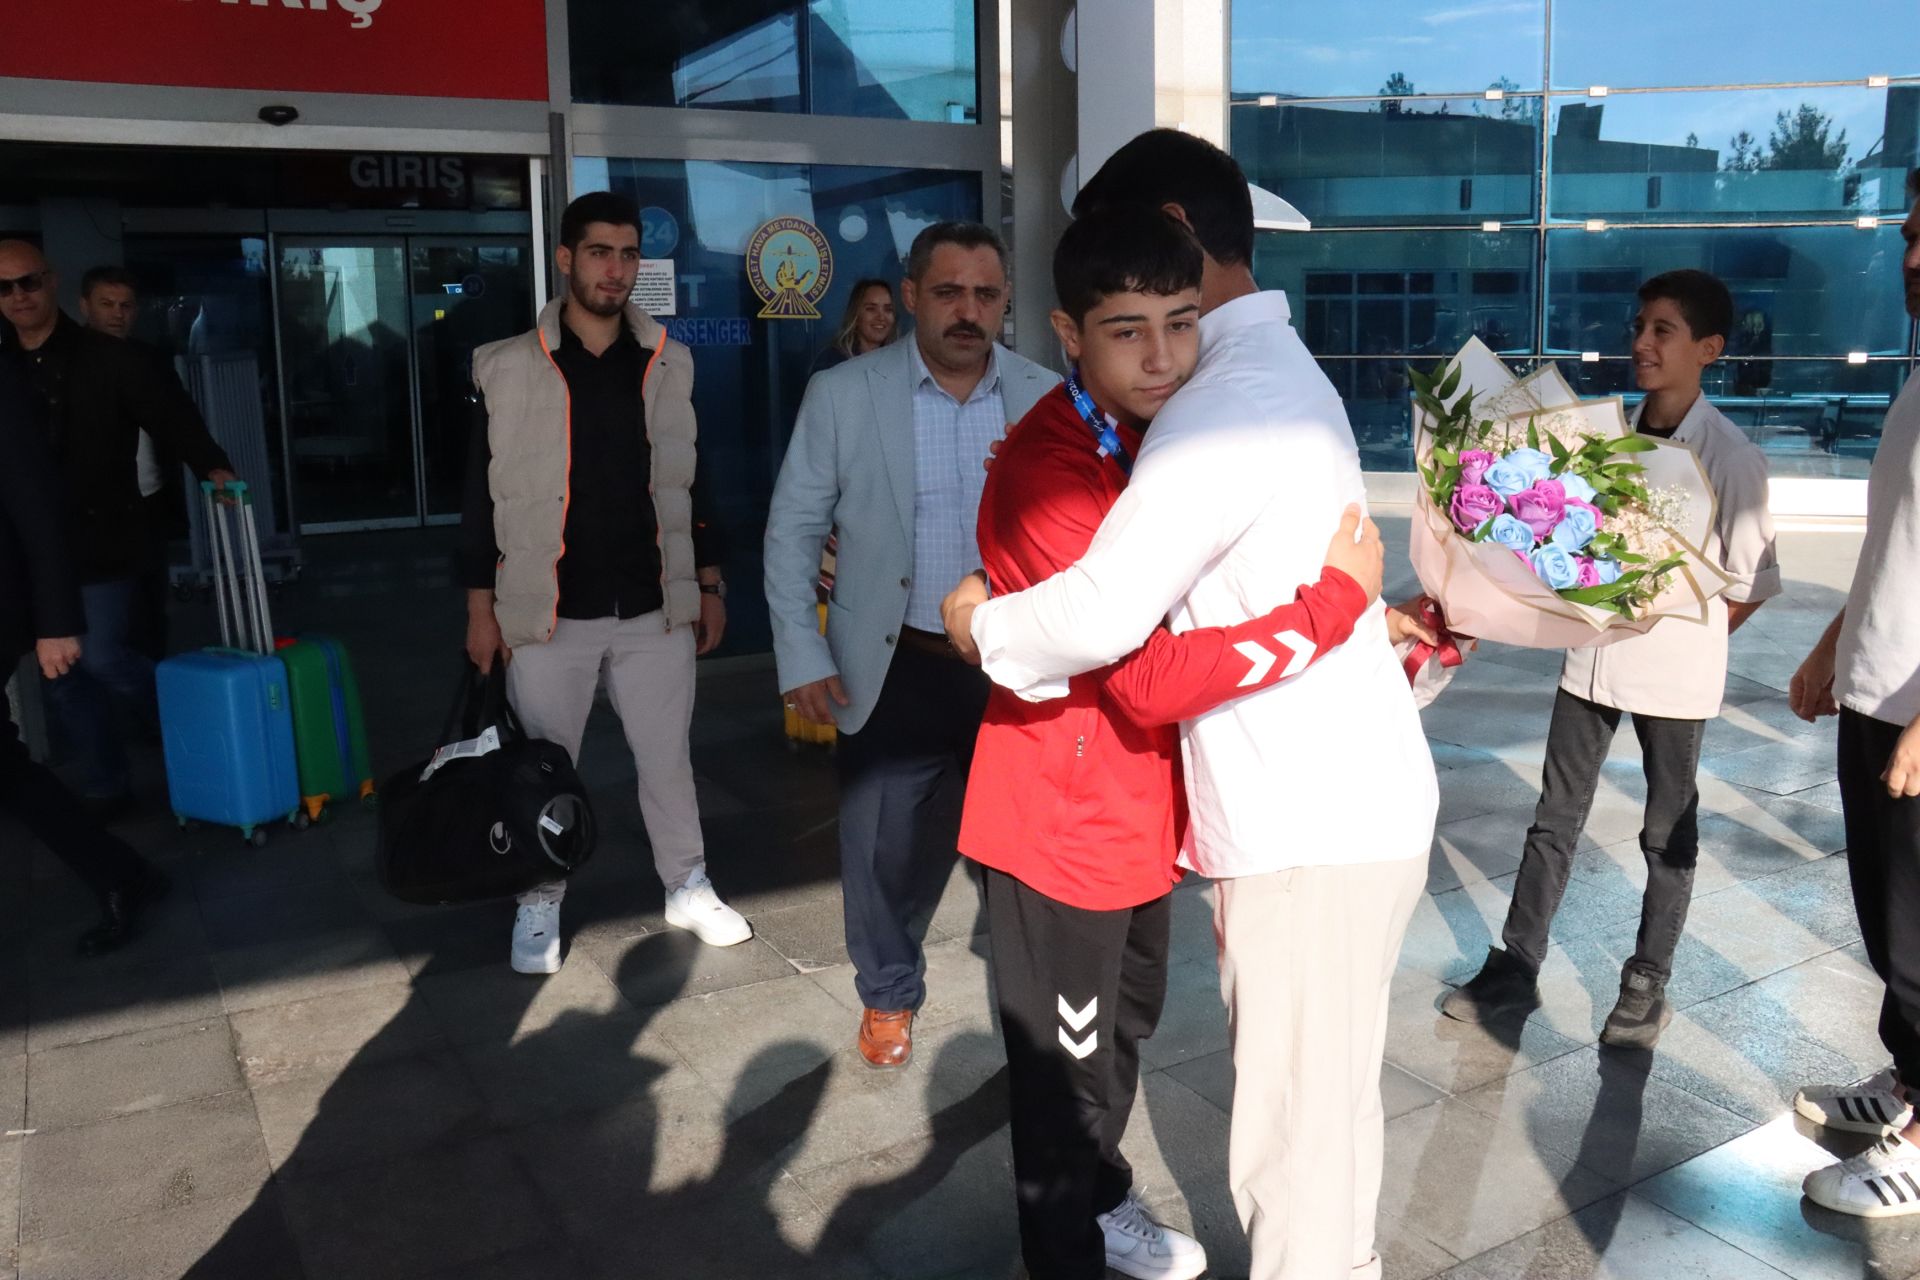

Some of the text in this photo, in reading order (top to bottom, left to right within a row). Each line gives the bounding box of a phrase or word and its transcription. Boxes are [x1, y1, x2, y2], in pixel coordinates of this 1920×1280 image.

[641, 221, 674, 244] 24
[751, 232, 769, 258] HAVA
[767, 219, 824, 248] MEYDANLARI
[750, 259, 771, 298] DEVLET
